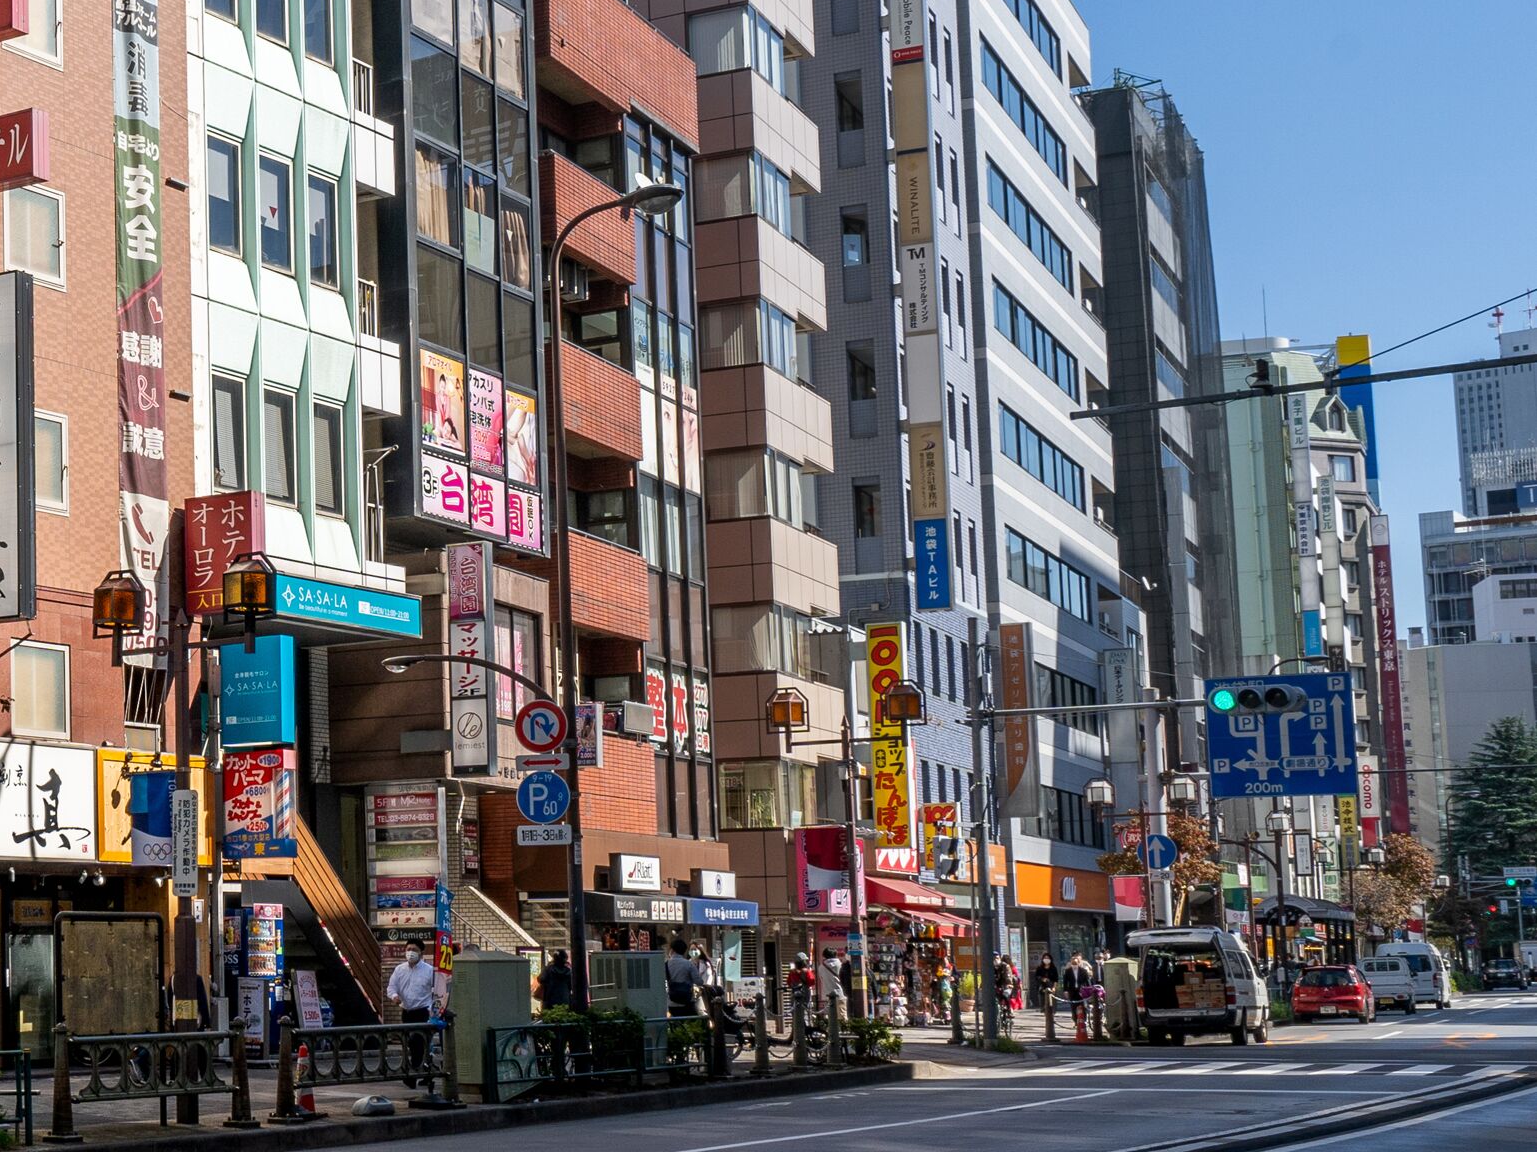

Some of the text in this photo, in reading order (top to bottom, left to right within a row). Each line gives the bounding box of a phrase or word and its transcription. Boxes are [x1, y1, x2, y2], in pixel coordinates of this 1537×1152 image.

[904, 21, 913, 45] Peace
[123, 164, 158, 264] 安全
[910, 175, 920, 235] WINALITE
[121, 330, 164, 369] 感謝
[122, 421, 165, 461] 誠意
[422, 468, 438, 497] 3F
[132, 547, 161, 572] TEL
[192, 502, 215, 588] オーロラ
[924, 526, 940, 600] 池袋TAビル
[196, 593, 223, 609] 入口
[457, 622, 479, 689] マッサージ
[457, 688, 481, 697] 2F
[454, 741, 486, 750] lemiest
[226, 754, 256, 771] カット
[232, 769, 265, 787] パーマ
[532, 773, 553, 783] 9-19
[1244, 782, 1284, 794] 200m
[1362, 764, 1373, 810] docomo
[231, 797, 254, 810] カット
[528, 783, 549, 816] P
[543, 800, 558, 816] 60
[874, 770, 908, 847] たんぽぽ
[182, 799, 191, 877] 防犯カメラ作動中
[400, 929, 432, 940] lemiest
